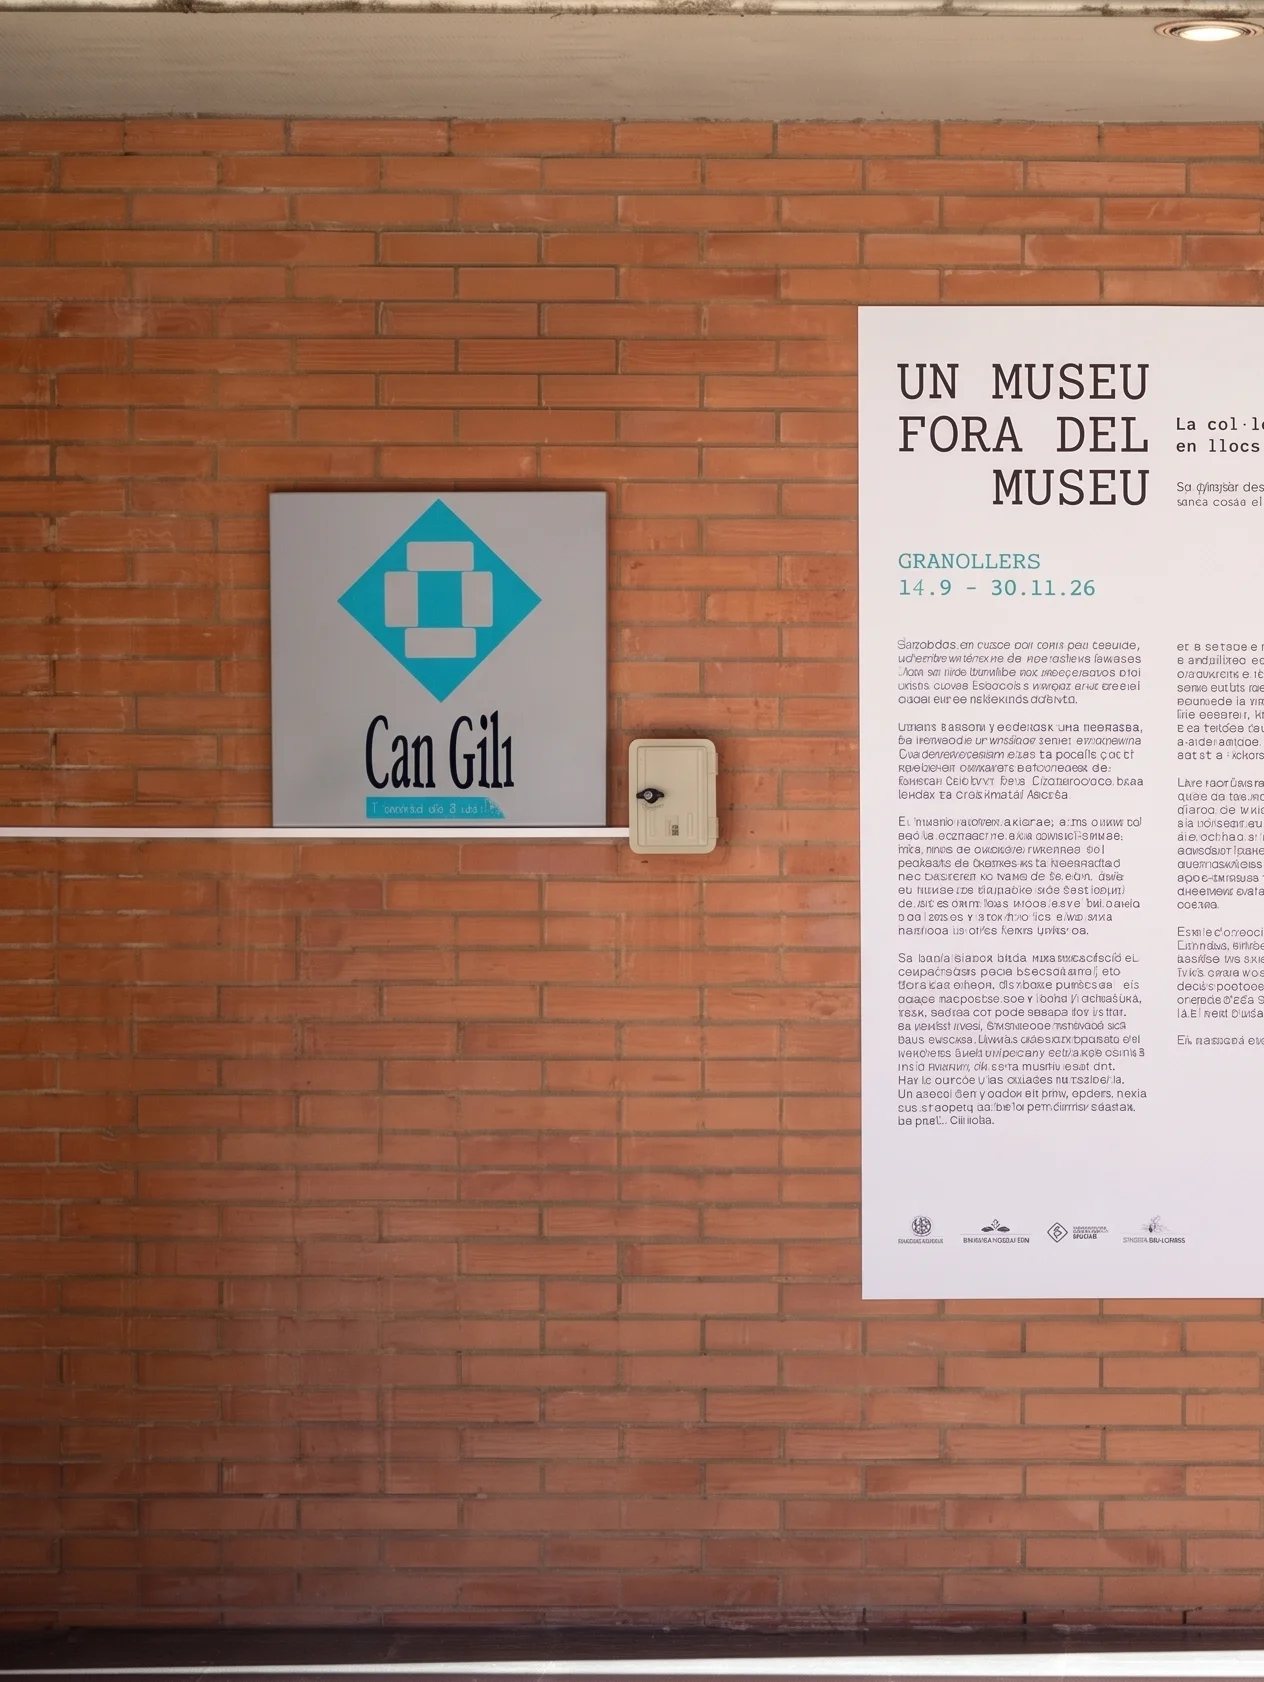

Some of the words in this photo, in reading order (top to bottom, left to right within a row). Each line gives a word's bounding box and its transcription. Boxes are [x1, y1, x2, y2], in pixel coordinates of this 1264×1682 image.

[897, 363, 959, 400] UN
[992, 363, 1150, 400] MUSEU
[899, 415, 1024, 453] FORA
[1057, 416, 1149, 453] DEL
[1176, 417, 1197, 431] La
[1176, 442, 1197, 453] en
[1208, 438, 1261, 453] llocs
[993, 468, 1150, 506] MUSEU
[898, 552, 1041, 570] GRANOLLERS
[899, 578, 952, 596] 14.9
[991, 579, 1096, 597] 30.11.26
[365, 714, 436, 789] Can
